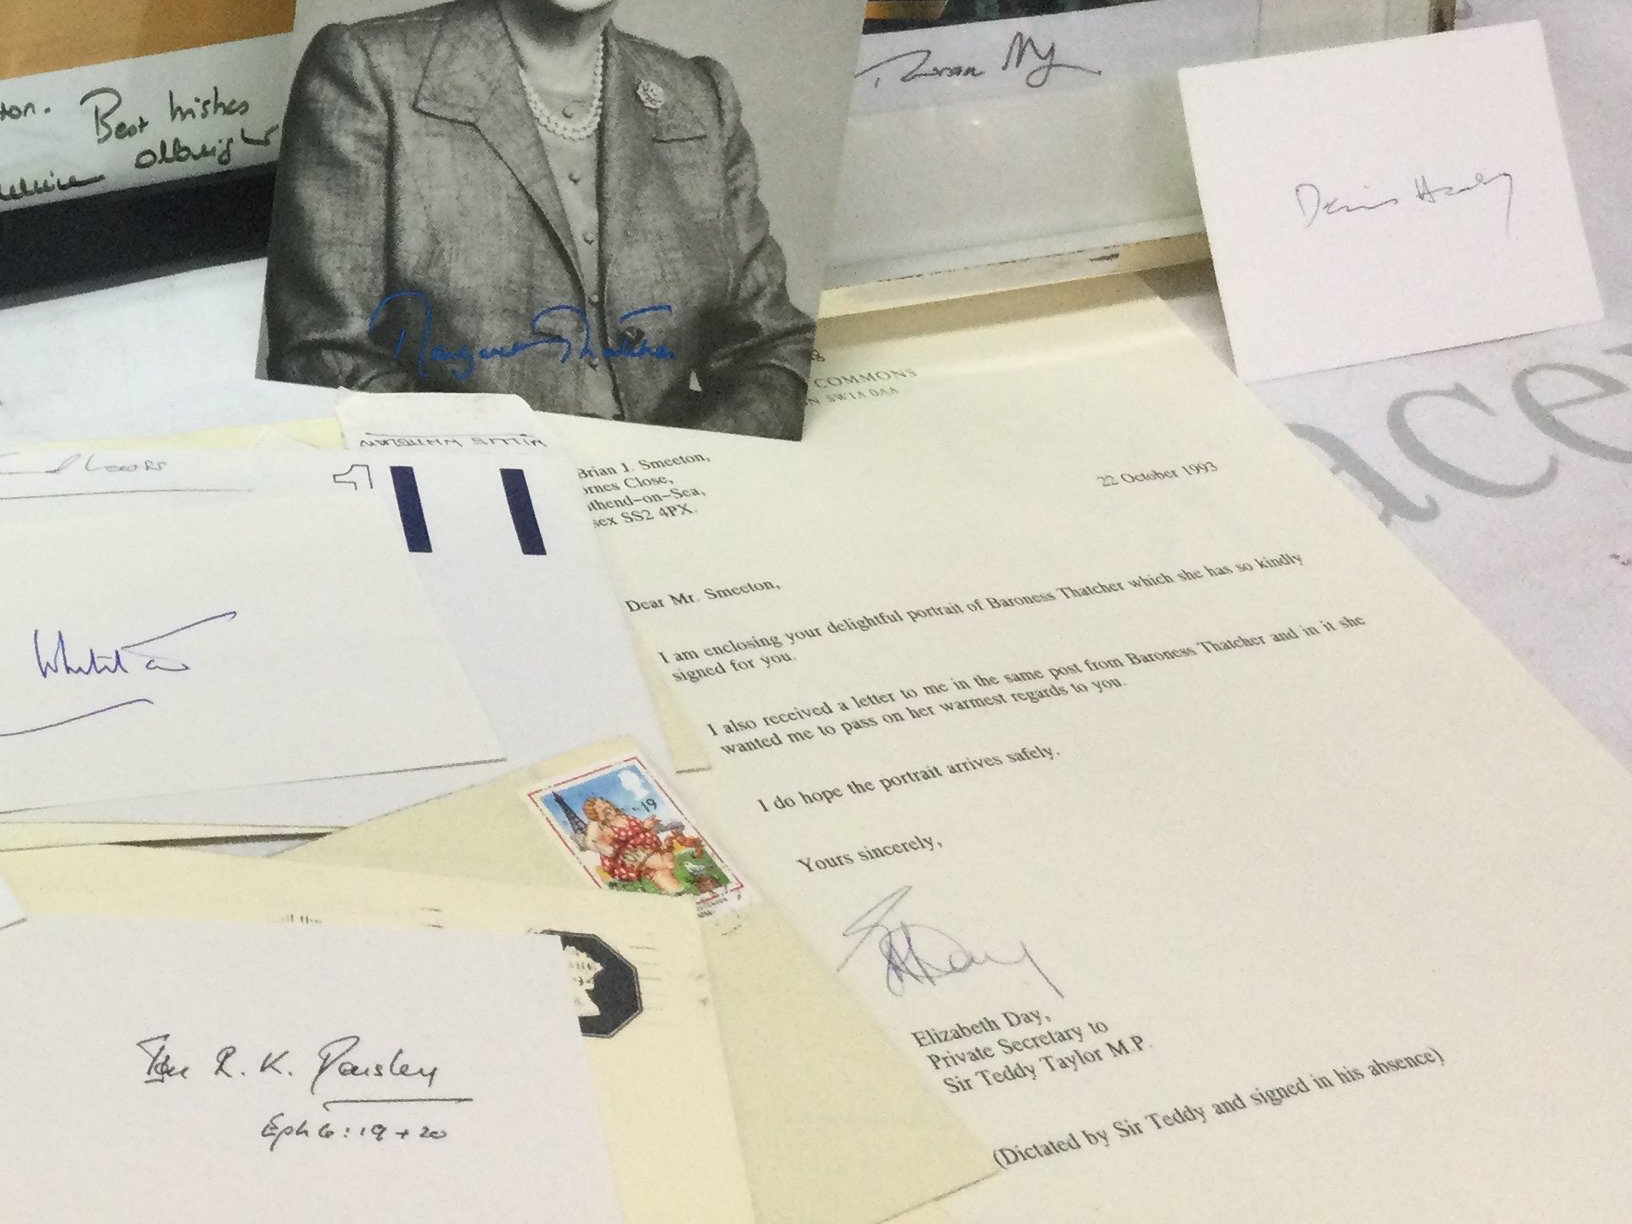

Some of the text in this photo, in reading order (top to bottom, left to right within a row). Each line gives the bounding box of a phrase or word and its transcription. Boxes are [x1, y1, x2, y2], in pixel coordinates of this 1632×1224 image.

[79, 87, 150, 144] Best
[814, 367, 917, 389] COMMONS
[577, 466, 617, 480] Brian
[638, 453, 711, 471] Smeeton,
[624, 476, 674, 490] Close,
[1098, 461, 1218, 488] 22 October 1993
[621, 509, 655, 524] SS2
[625, 580, 781, 614] Dear Mr. Smeeton,
[658, 552, 1303, 665] I am enclosing your delightful portrait of Baroness Thatcher which she has so kindly
[672, 651, 797, 684] signed for you.
[706, 614, 1366, 737] I also received a letter to me in the same post from Baroness Thatcher and in it she
[720, 676, 1127, 756] wanted me to pass on her warmest regards to you.
[757, 743, 1061, 813] I do hope the portrait arrives safely.
[796, 834, 943, 874] Yours sincerely,
[911, 1006, 1052, 1049] Elizabeth Day,
[928, 1017, 1109, 1072] Private Secretary to
[943, 1075, 974, 1095] Sir
[975, 1061, 1037, 1089] Teddy
[1040, 1047, 1103, 1076] Taylor
[992, 1047, 1444, 1170] (Dictated by Sir Teddy and signed in his absence)
